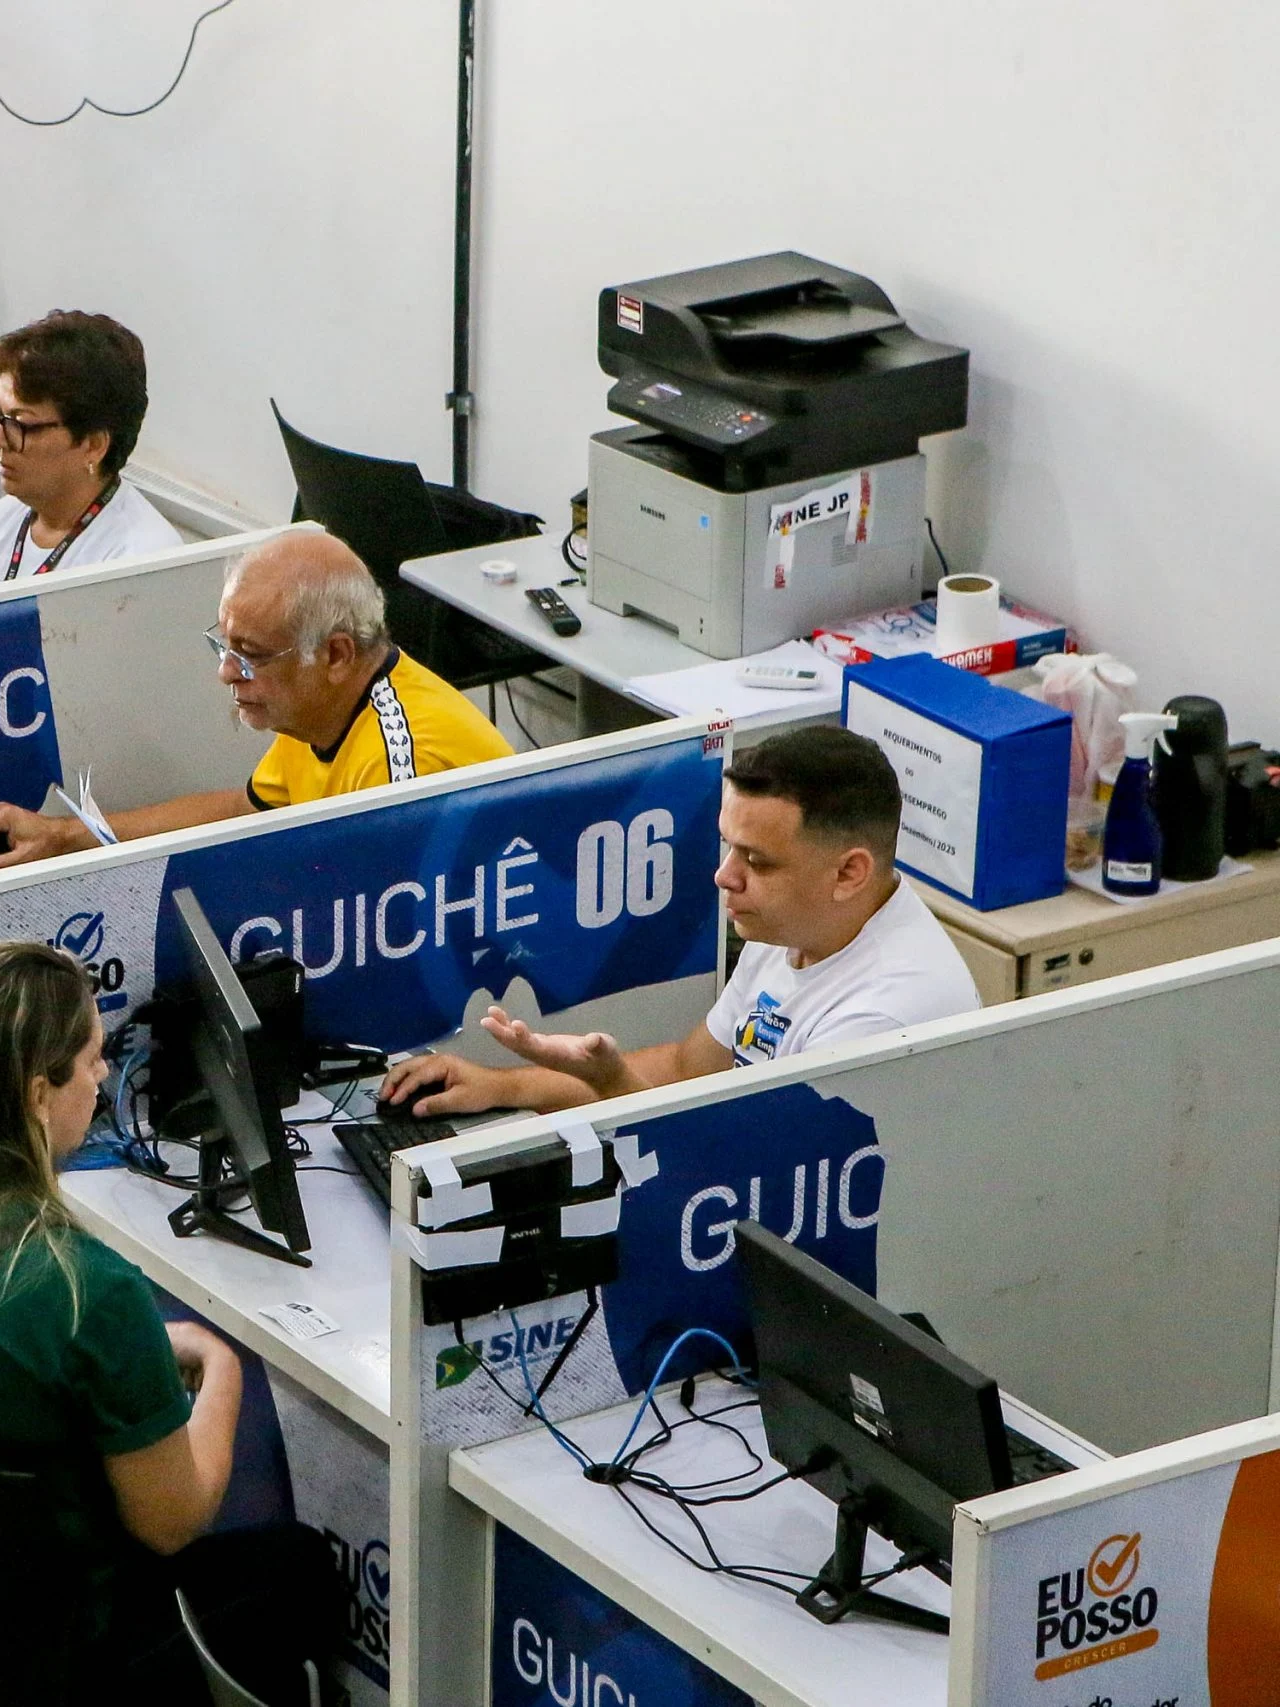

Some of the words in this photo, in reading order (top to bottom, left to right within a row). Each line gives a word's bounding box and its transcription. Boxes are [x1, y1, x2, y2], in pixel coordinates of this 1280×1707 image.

[827, 492, 849, 513] JP
[883, 728, 942, 764] REQUERIMENTOS
[230, 836, 539, 979] GUICHÊ
[575, 808, 675, 929] 06
[487, 1315, 577, 1363] SINE
[1037, 1568, 1086, 1619] EU
[1036, 1586, 1159, 1659] POSSO
[1063, 1641, 1128, 1669] CRESCER
